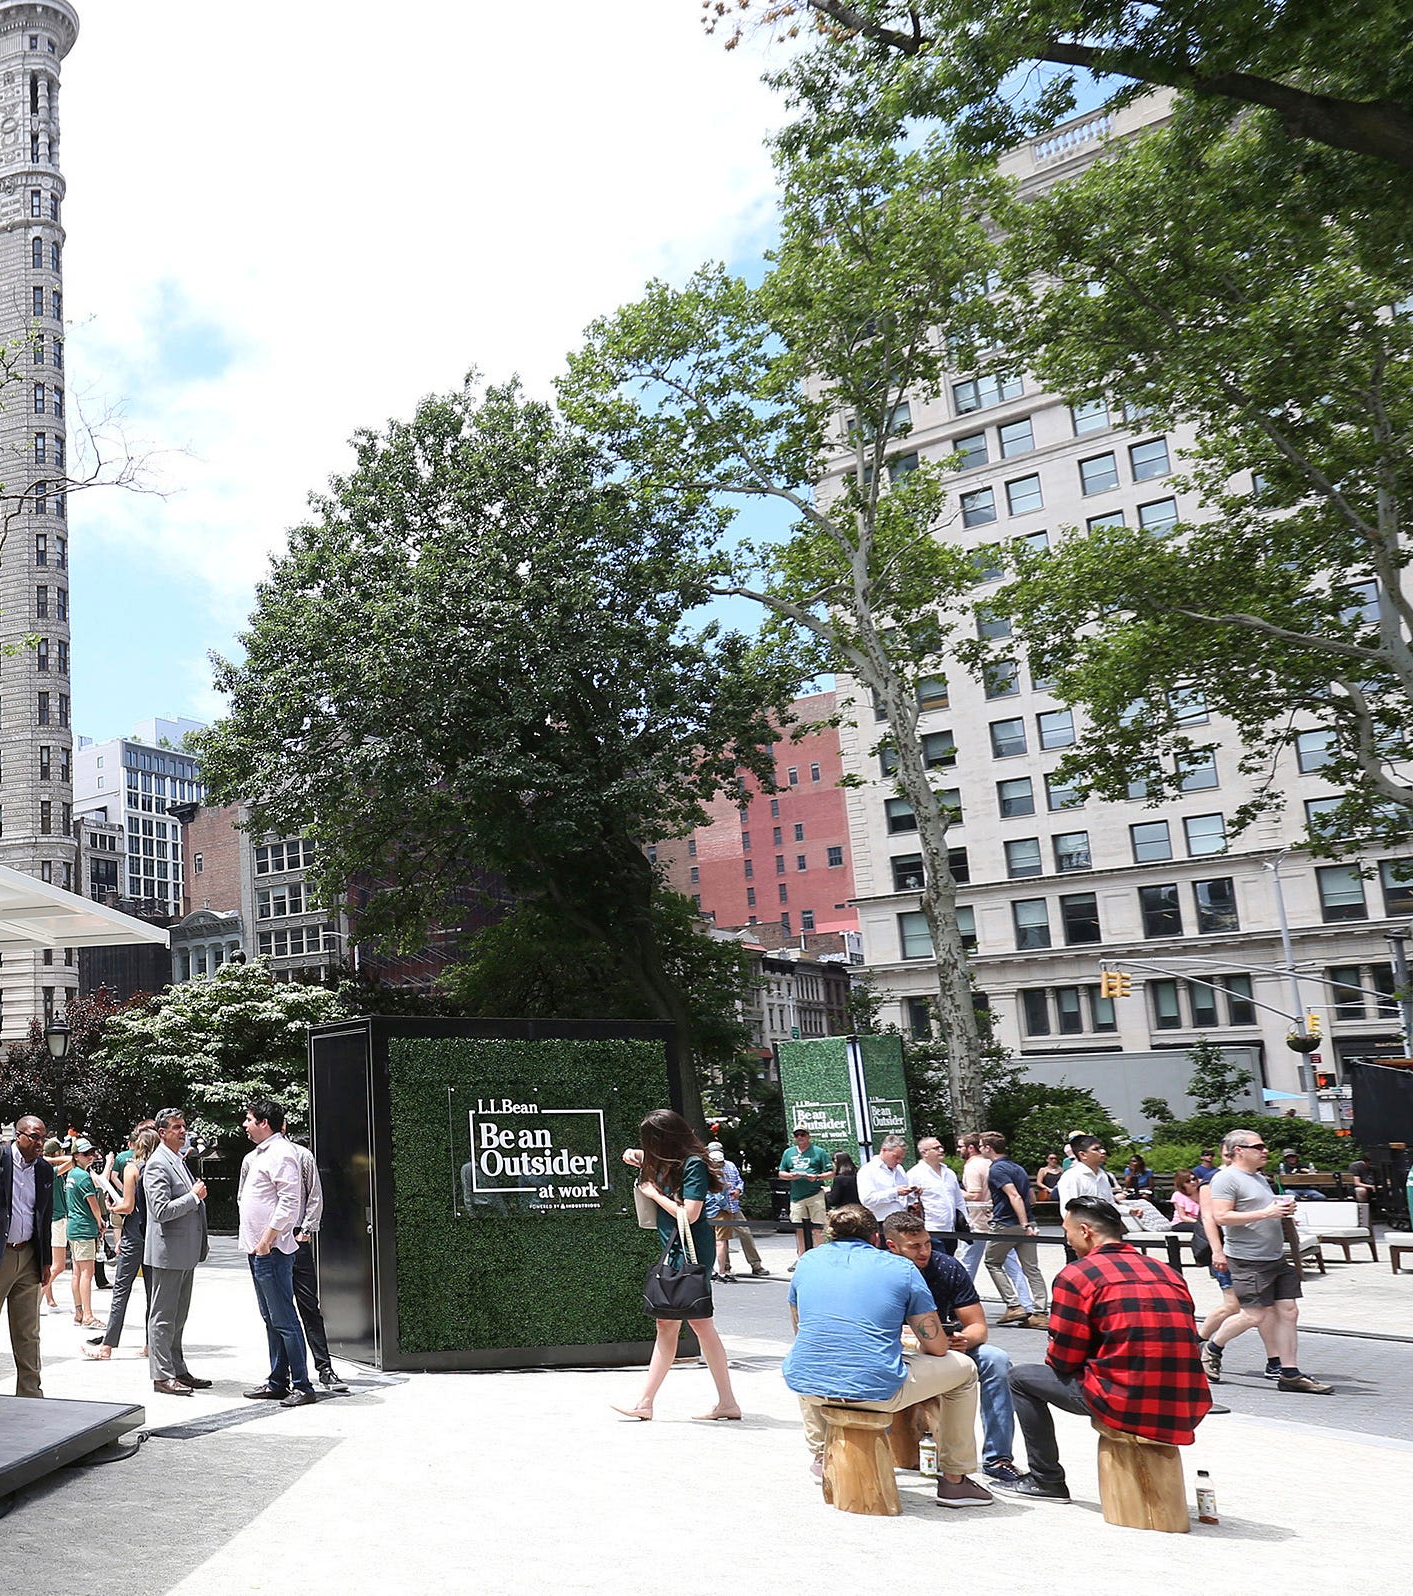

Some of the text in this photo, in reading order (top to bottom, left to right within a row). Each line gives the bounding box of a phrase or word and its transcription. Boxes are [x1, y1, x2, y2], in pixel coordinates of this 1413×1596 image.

[477, 1098, 539, 1115] L.L.Bean
[797, 1119, 847, 1130] Outsider
[872, 1115, 905, 1127] Outsider
[478, 1122, 553, 1149] Be an
[479, 1149, 599, 1177] Outsider
[538, 1182, 600, 1199] at work
